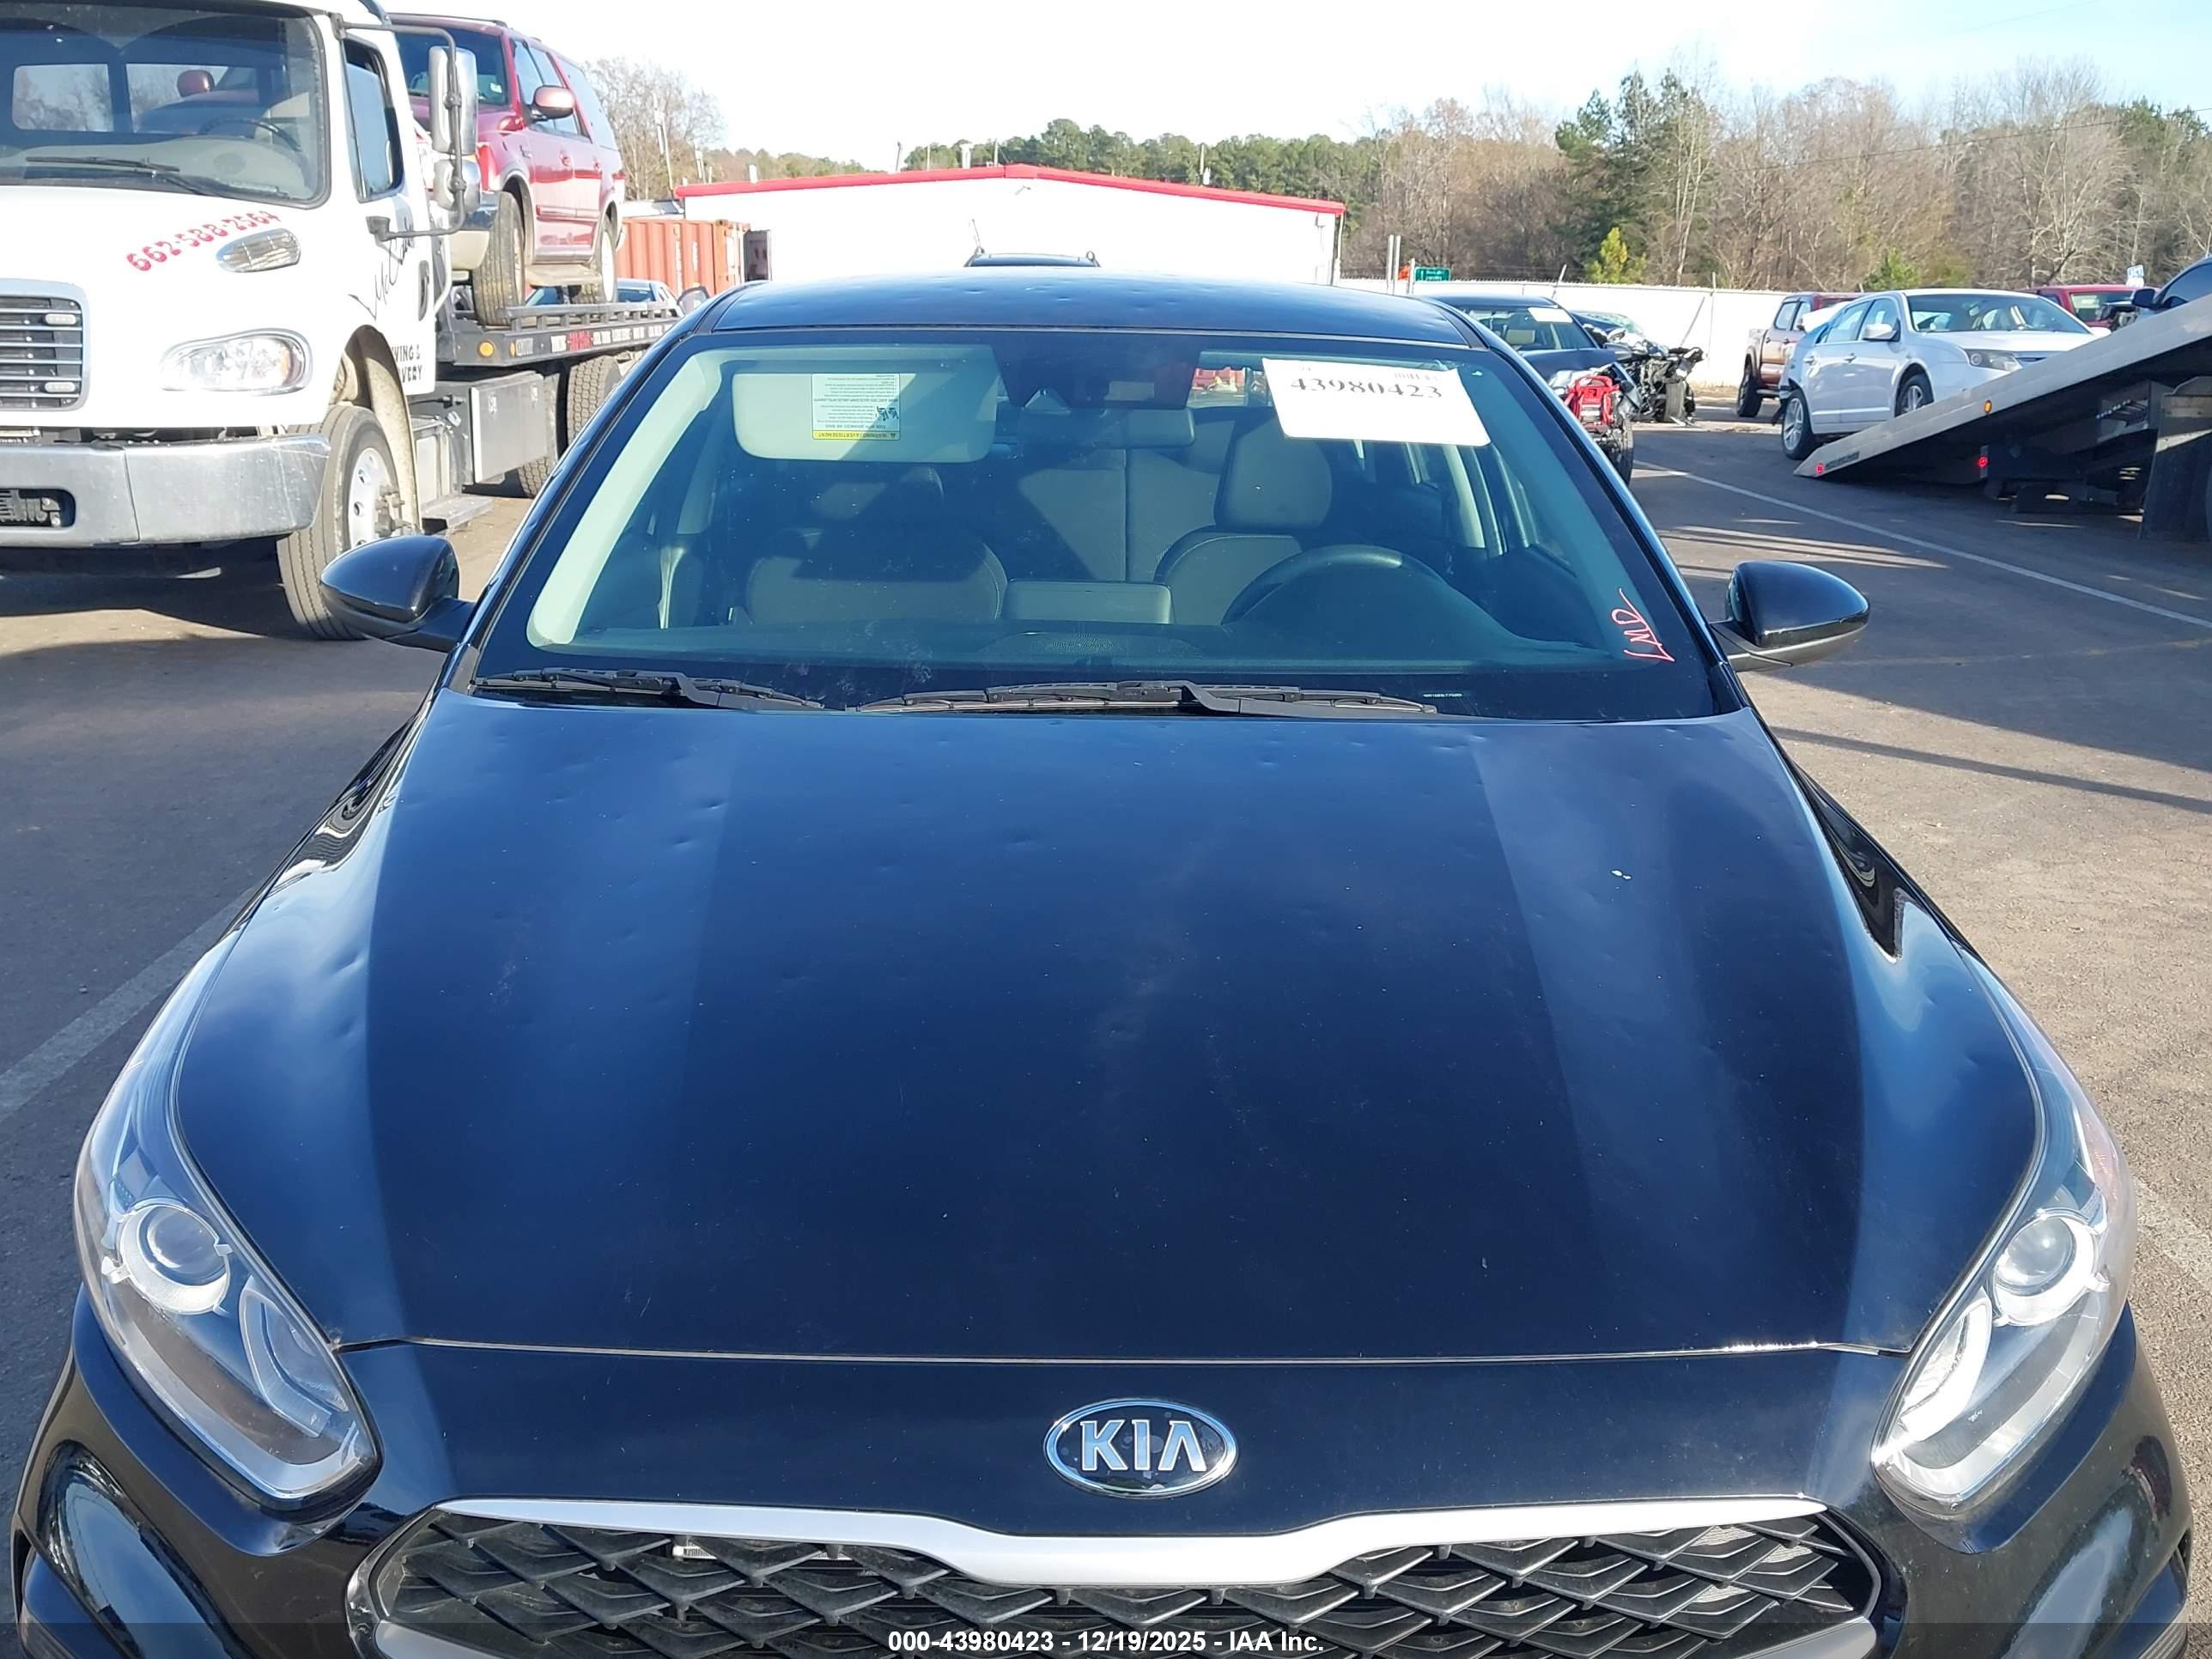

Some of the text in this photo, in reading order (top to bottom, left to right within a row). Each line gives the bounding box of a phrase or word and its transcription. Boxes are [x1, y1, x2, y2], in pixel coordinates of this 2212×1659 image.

[392, 344, 414, 362] WING
[1291, 378, 1443, 398] 43980423
[1079, 1419, 1207, 1471] KIA
